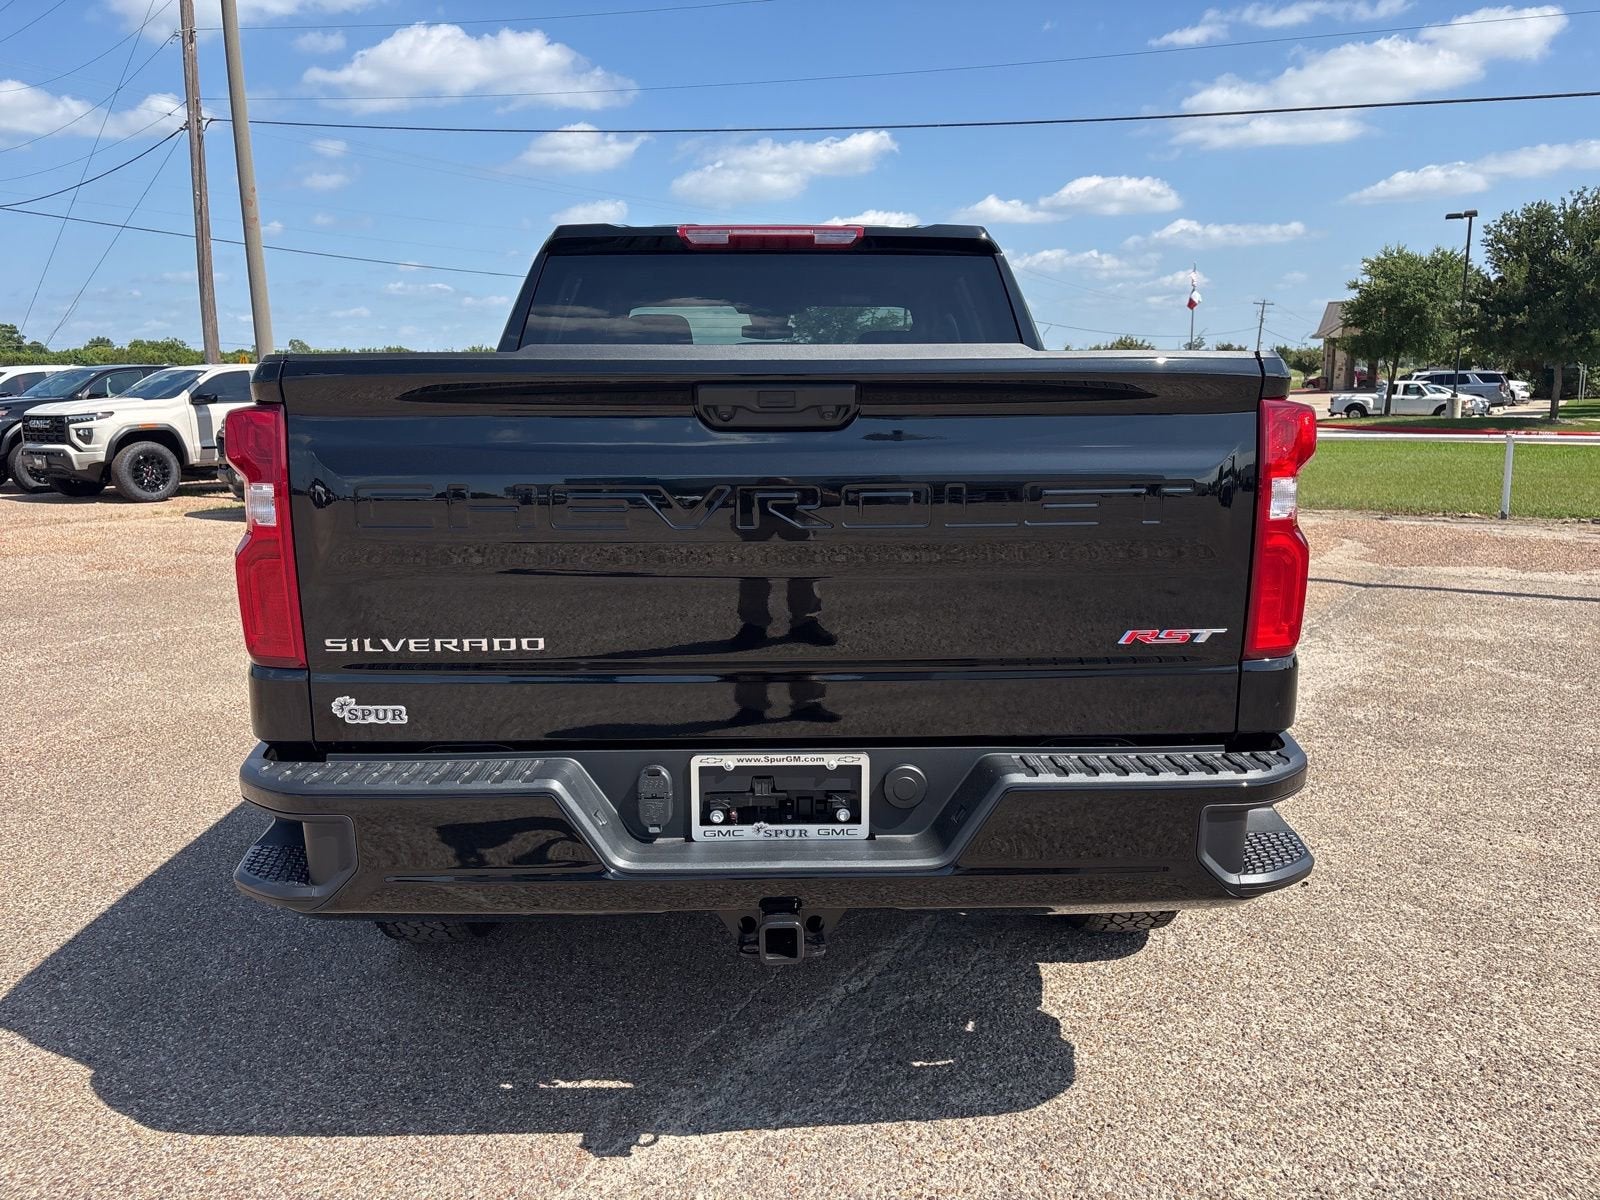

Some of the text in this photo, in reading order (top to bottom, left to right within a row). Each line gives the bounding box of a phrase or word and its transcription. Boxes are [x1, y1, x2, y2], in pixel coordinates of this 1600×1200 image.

[353, 480, 1195, 530] CHEVROLET
[1117, 627, 1228, 645] RST
[324, 638, 545, 652] SILVERADO
[347, 708, 406, 721] SPUR
[736, 755, 825, 764] www.SpurGM.com
[703, 828, 858, 838] GMC SPUR GMC
